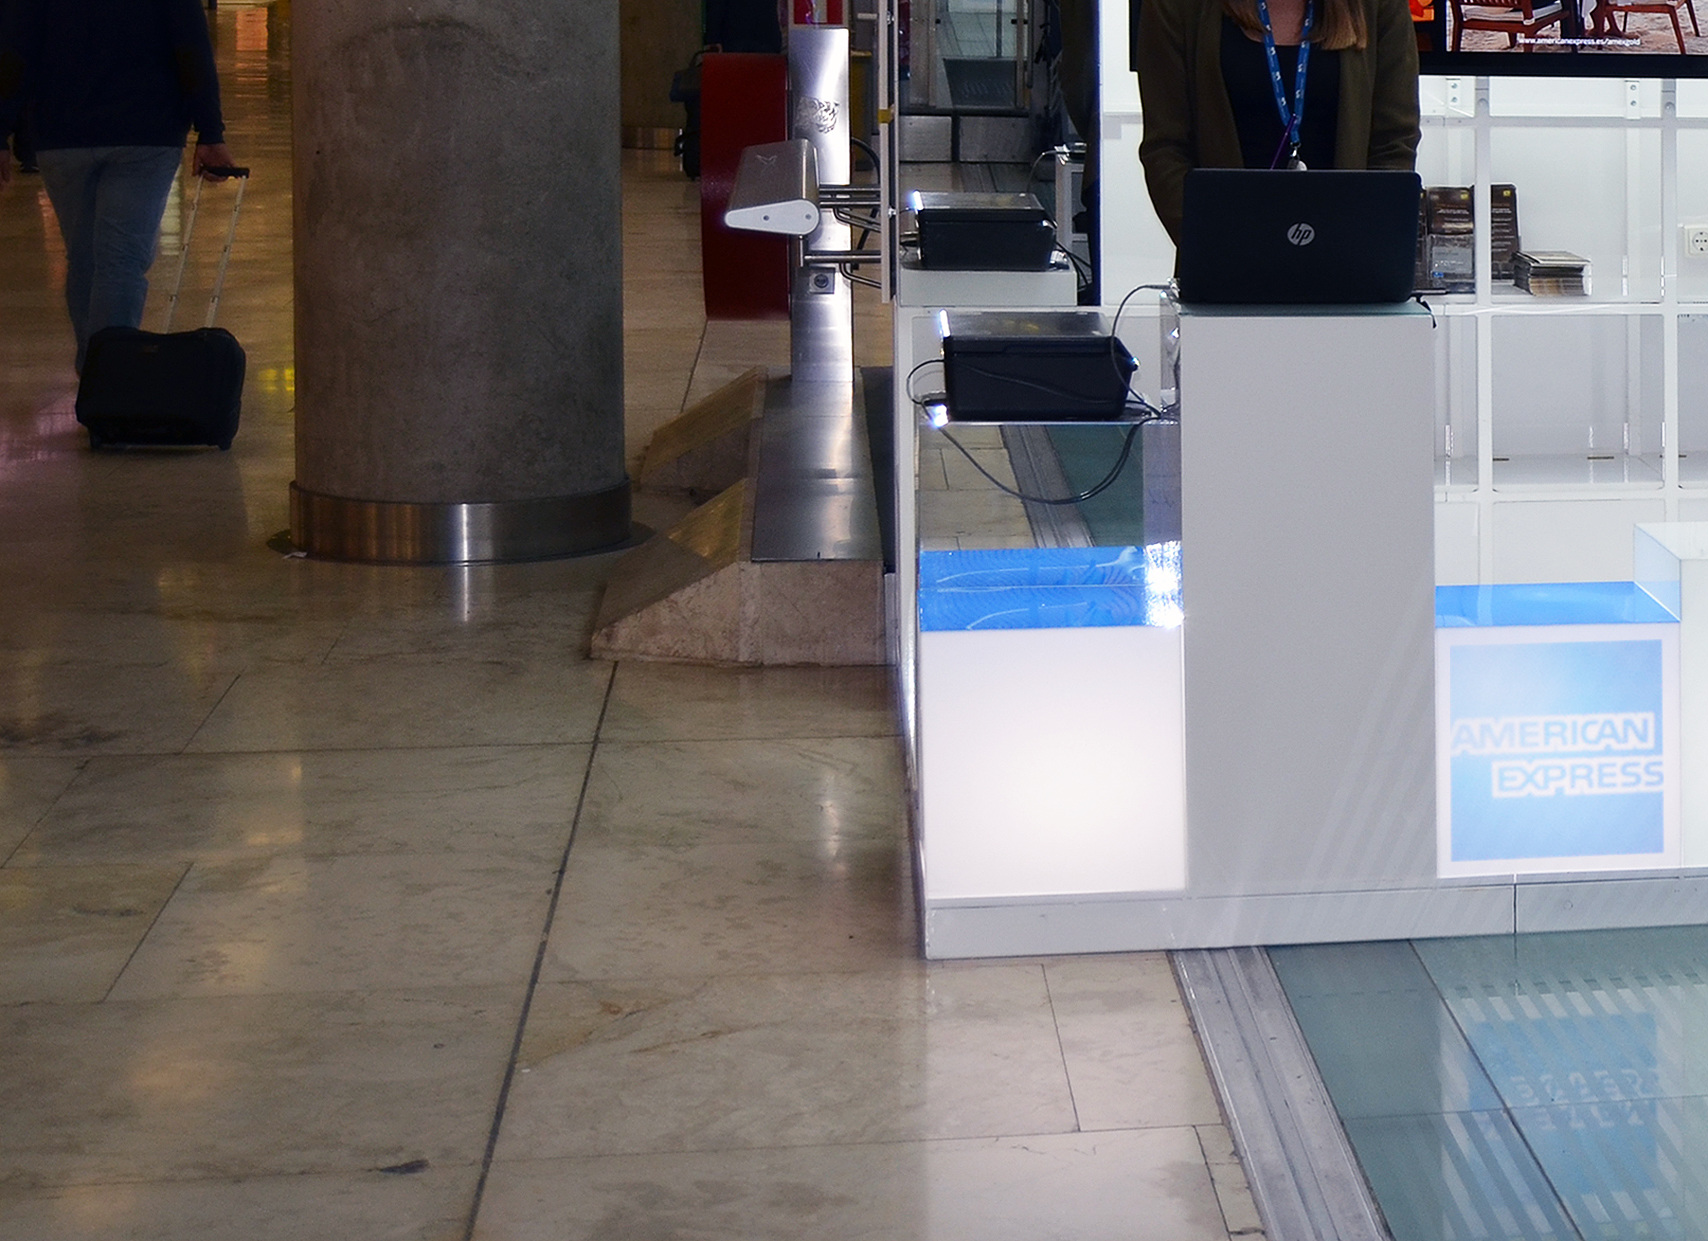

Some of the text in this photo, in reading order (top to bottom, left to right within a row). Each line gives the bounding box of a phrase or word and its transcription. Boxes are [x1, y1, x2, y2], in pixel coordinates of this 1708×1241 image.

[1288, 223, 1315, 246] hp
[1452, 716, 1651, 751] AMERICAN
[1496, 759, 1664, 793] EXPRESS
